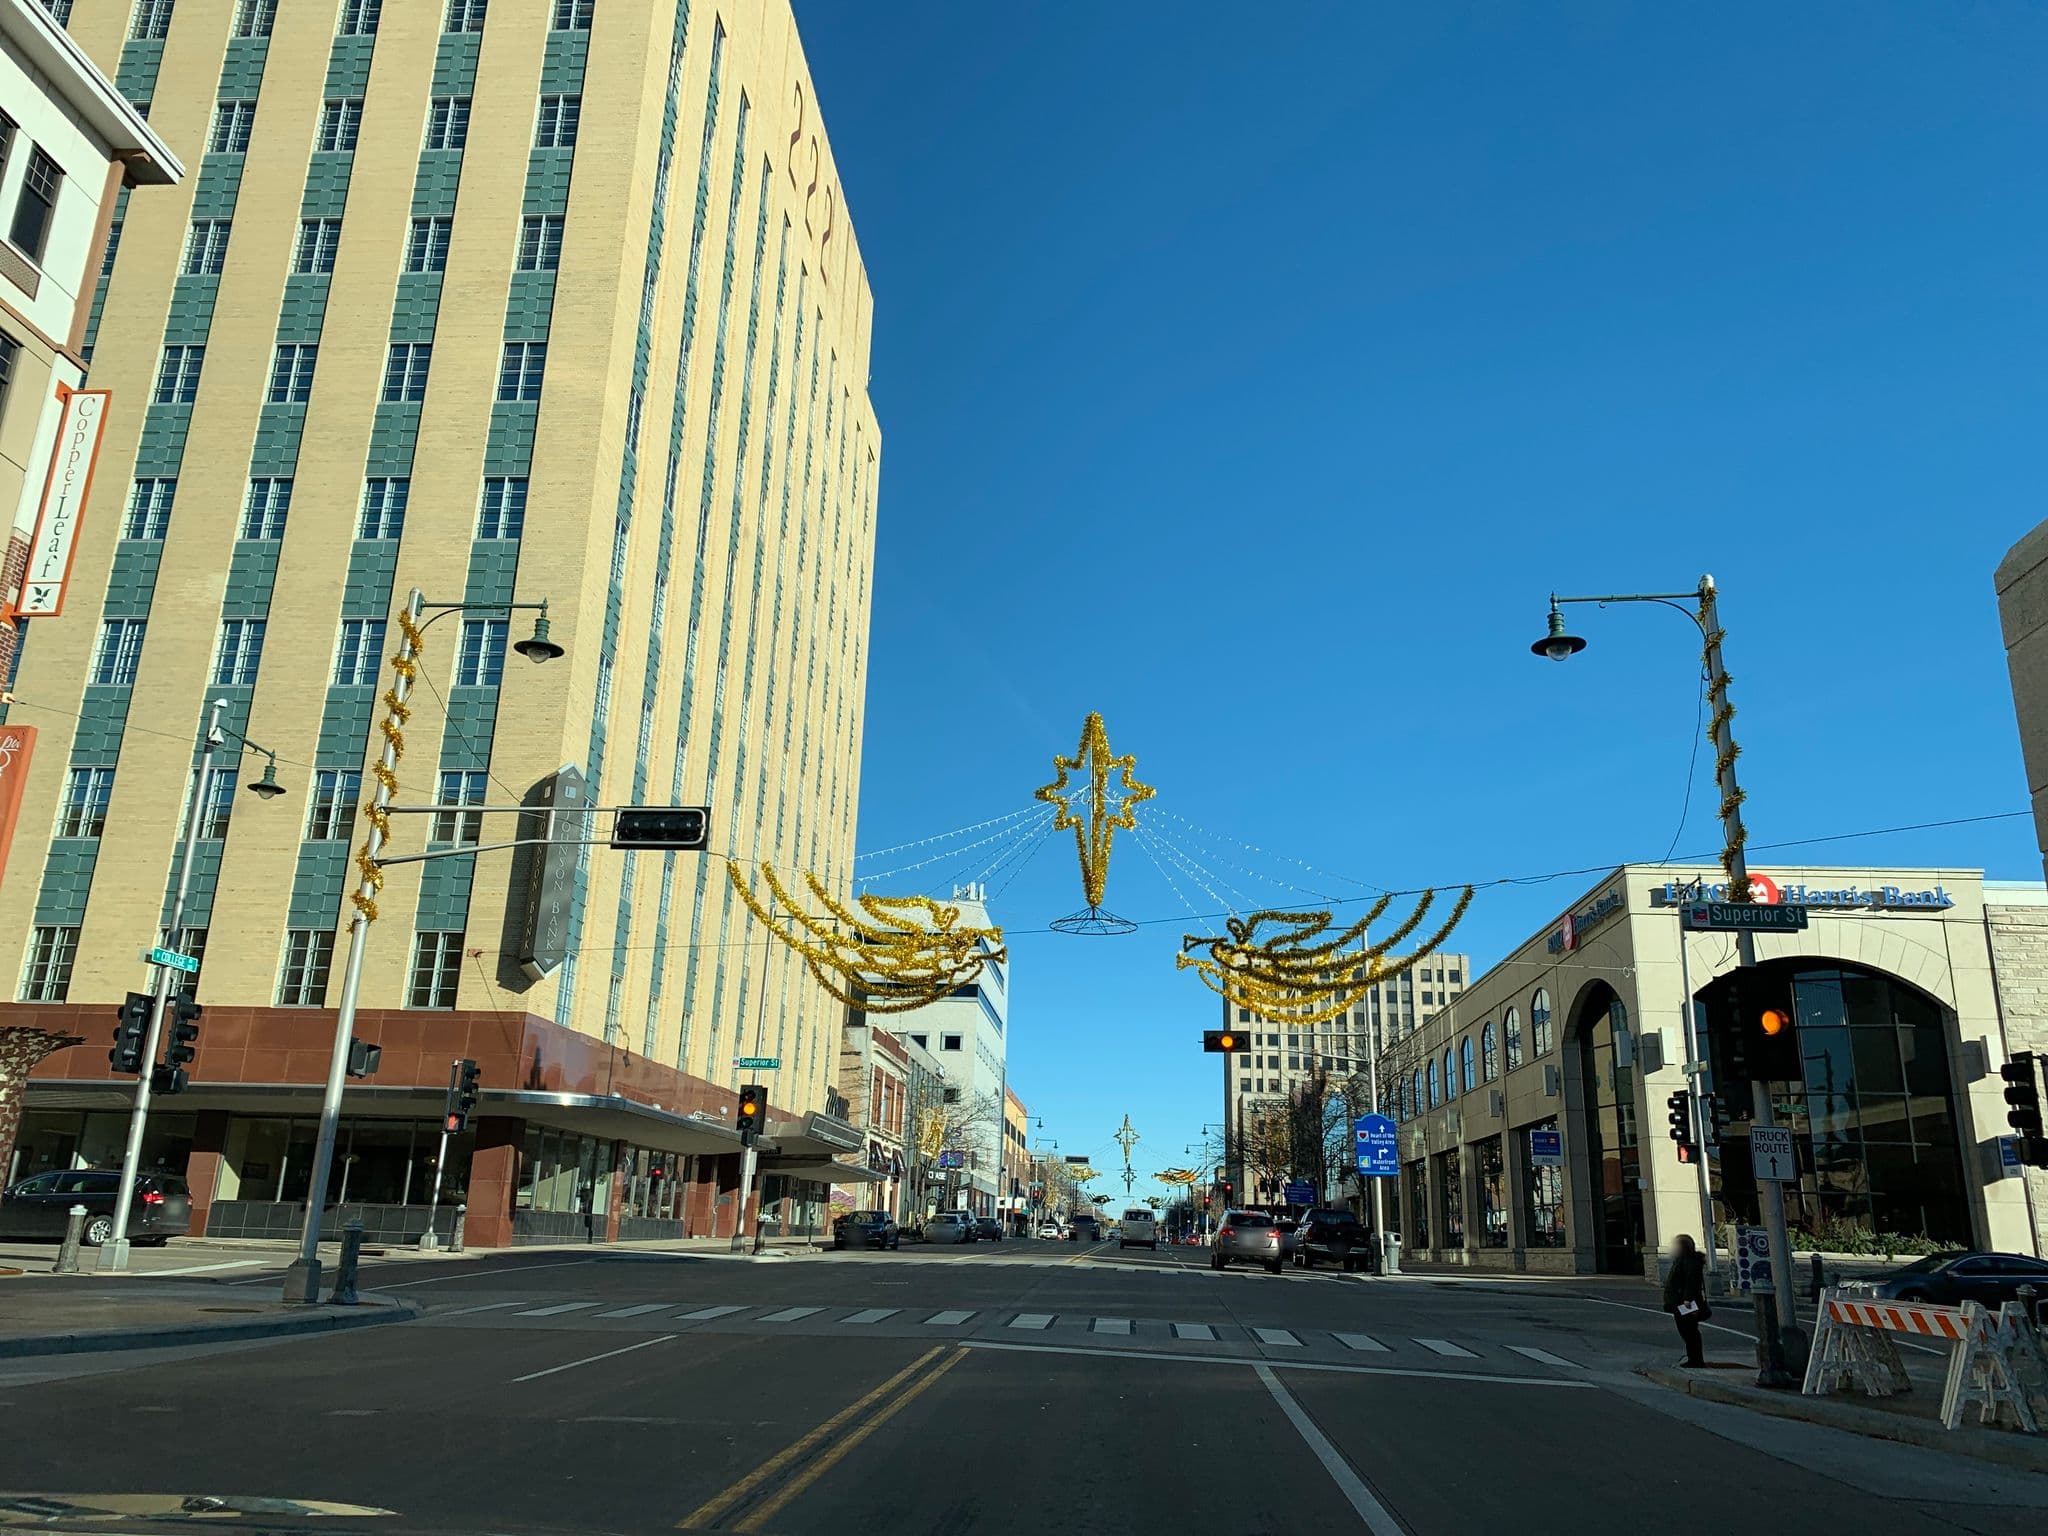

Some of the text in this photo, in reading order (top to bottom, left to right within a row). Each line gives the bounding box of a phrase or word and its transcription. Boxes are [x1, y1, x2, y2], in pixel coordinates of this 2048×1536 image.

[41, 396, 96, 578] CopperLeaf
[546, 806, 572, 951] JOHNSON BANK
[1783, 884, 1873, 905] Harris
[1880, 885, 1955, 906] Bank
[1712, 906, 1804, 924] Superior St
[524, 901, 535, 949] BANK
[161, 951, 185, 968] COLLEGE
[740, 1058, 778, 1067] Superior St
[1753, 1130, 1788, 1142] TRUCK
[1754, 1142, 1790, 1154] ROUTE
